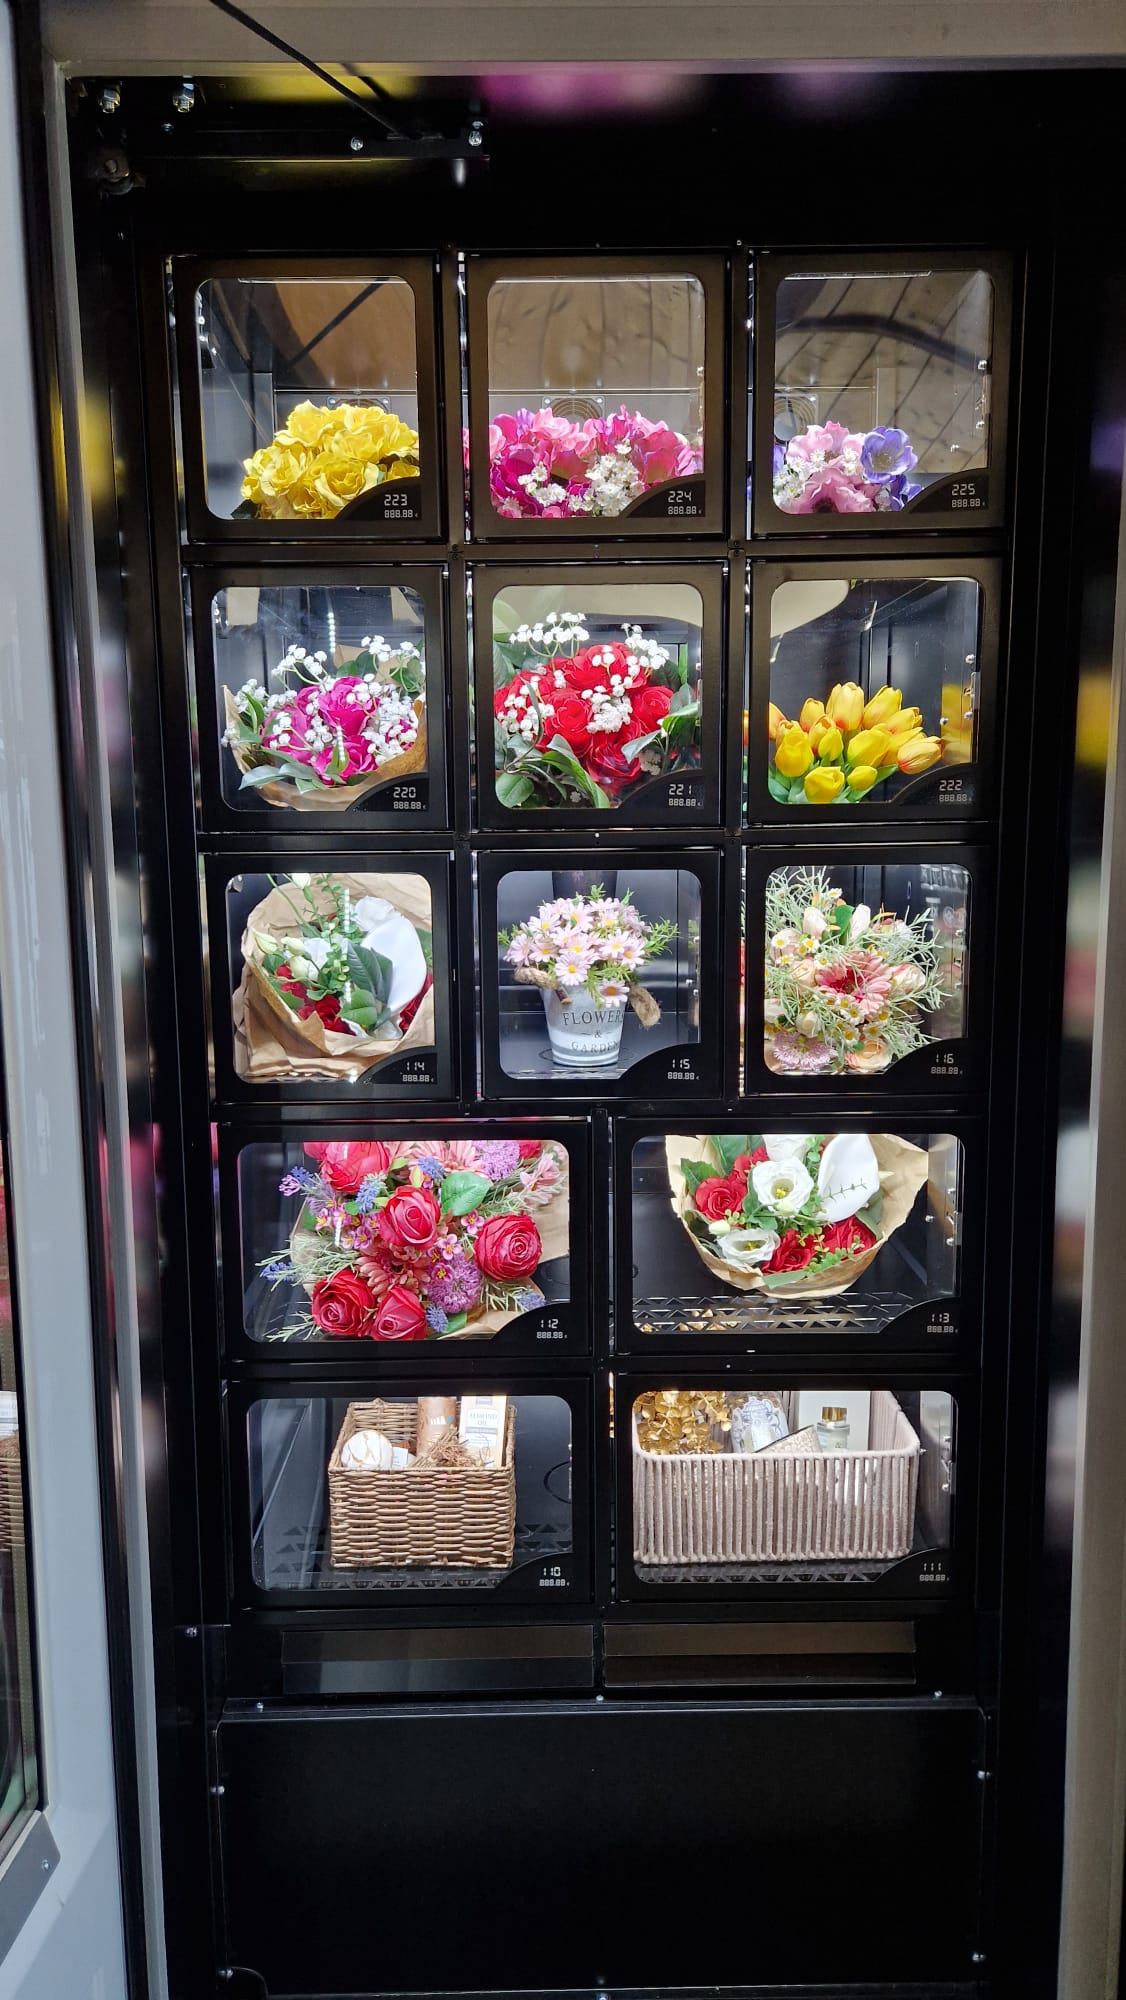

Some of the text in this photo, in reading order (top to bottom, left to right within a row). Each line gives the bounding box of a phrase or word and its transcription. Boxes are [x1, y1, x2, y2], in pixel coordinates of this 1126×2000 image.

[951, 483, 976, 495] 225
[384, 494, 408, 506] 223
[668, 491, 692, 502] 224
[668, 784, 692, 796] 221
[939, 780, 962, 792] 222
[393, 787, 417, 798] 220
[571, 1039, 619, 1054] GARDEN
[672, 1059, 690, 1070] 115
[936, 1054, 954, 1064] 116
[407, 1062, 425, 1071] 114
[932, 1313, 950, 1323] 113
[541, 1319, 559, 1329] 112
[543, 1566, 561, 1576] 110
[924, 1563, 942, 1571] 111
